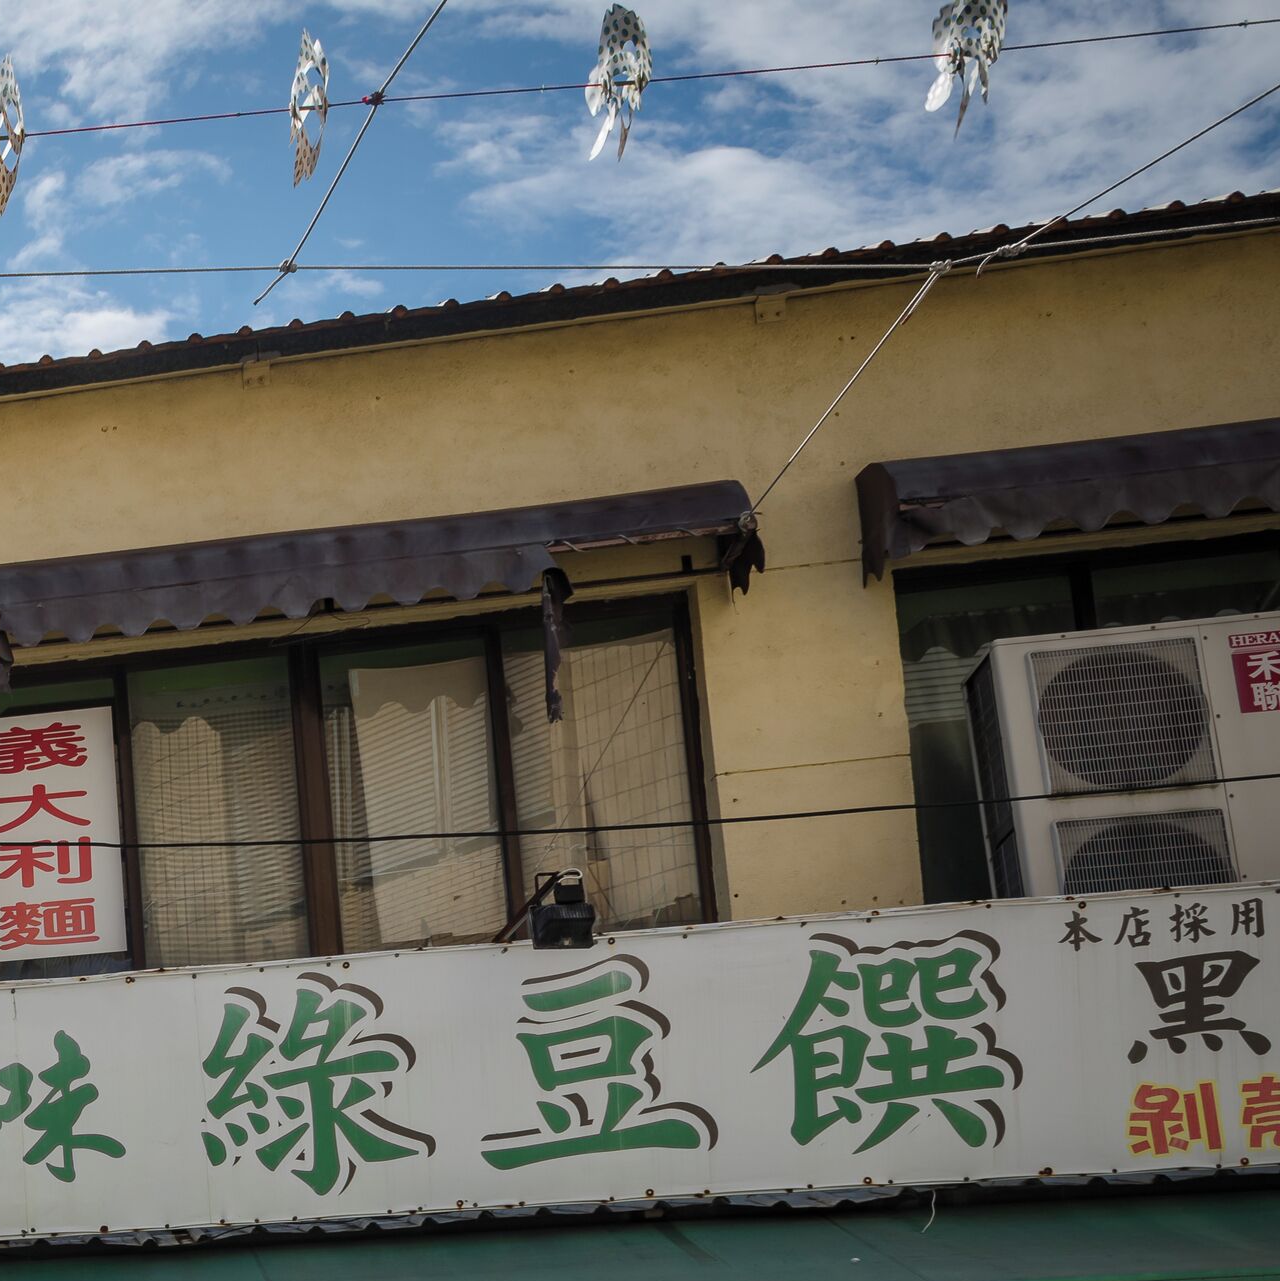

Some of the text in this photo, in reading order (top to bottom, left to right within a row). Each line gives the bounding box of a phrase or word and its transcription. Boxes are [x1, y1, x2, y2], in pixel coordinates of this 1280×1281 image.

[1229, 631, 1280, 647] HERA
[1059, 897, 1265, 952] 本店採用
[1127, 949, 1272, 1065] 黑
[200, 929, 1025, 1199] 綠豆饌
